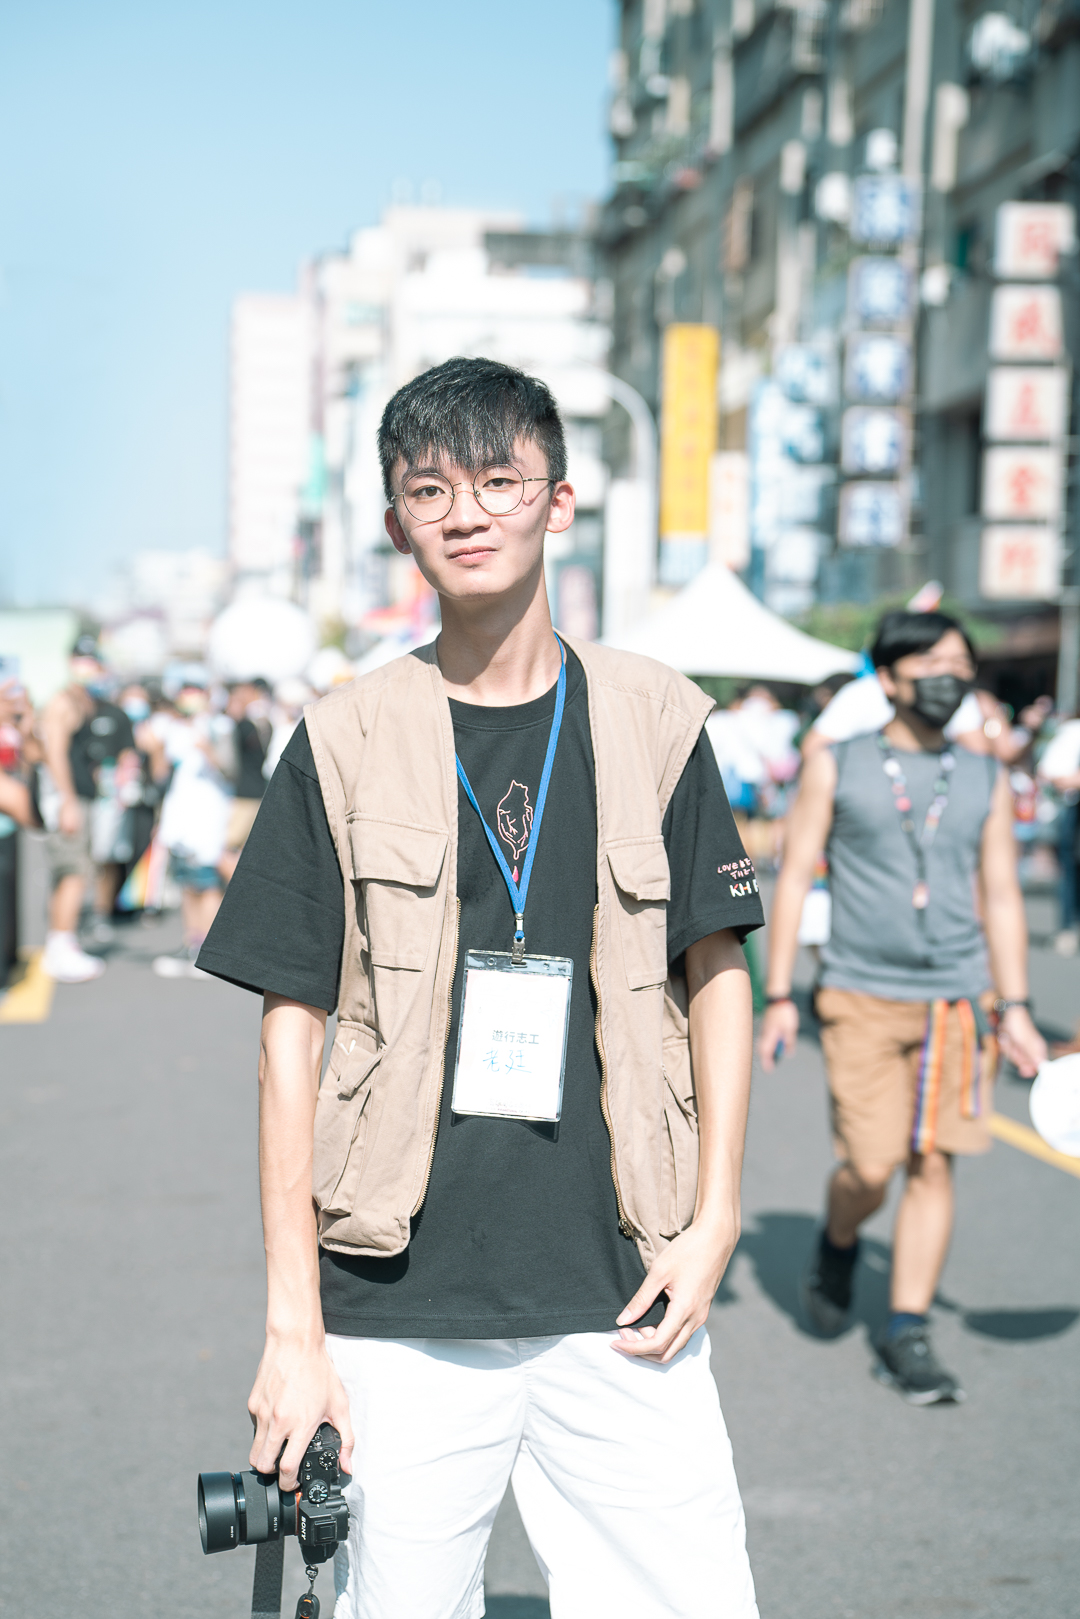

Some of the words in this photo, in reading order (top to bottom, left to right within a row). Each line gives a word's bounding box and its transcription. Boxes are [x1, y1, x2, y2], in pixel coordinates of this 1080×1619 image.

[717, 862, 739, 874] LOVE
[491, 1029, 540, 1045] 遊行志工
